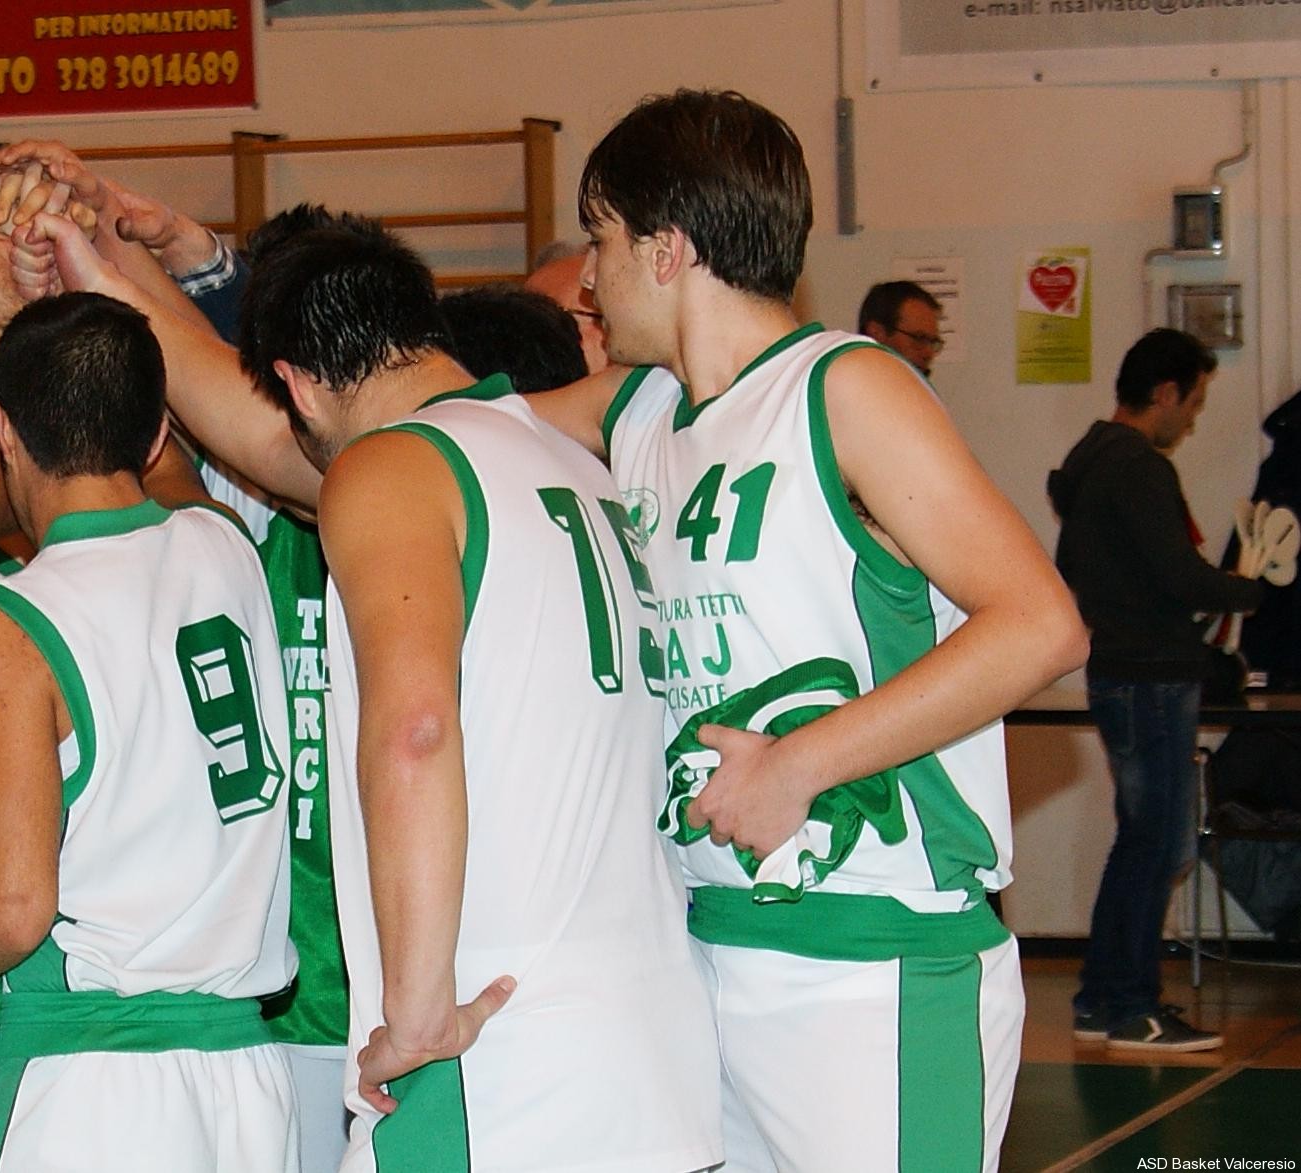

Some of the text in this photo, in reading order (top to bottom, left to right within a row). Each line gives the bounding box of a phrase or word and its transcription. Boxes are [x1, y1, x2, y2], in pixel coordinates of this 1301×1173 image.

[34, 8, 239, 39] PER INFORMAZIONI:
[57, 57, 106, 92] 328
[115, 50, 240, 89] 3014689
[676, 461, 776, 566] 41
[175, 613, 286, 825] 9
